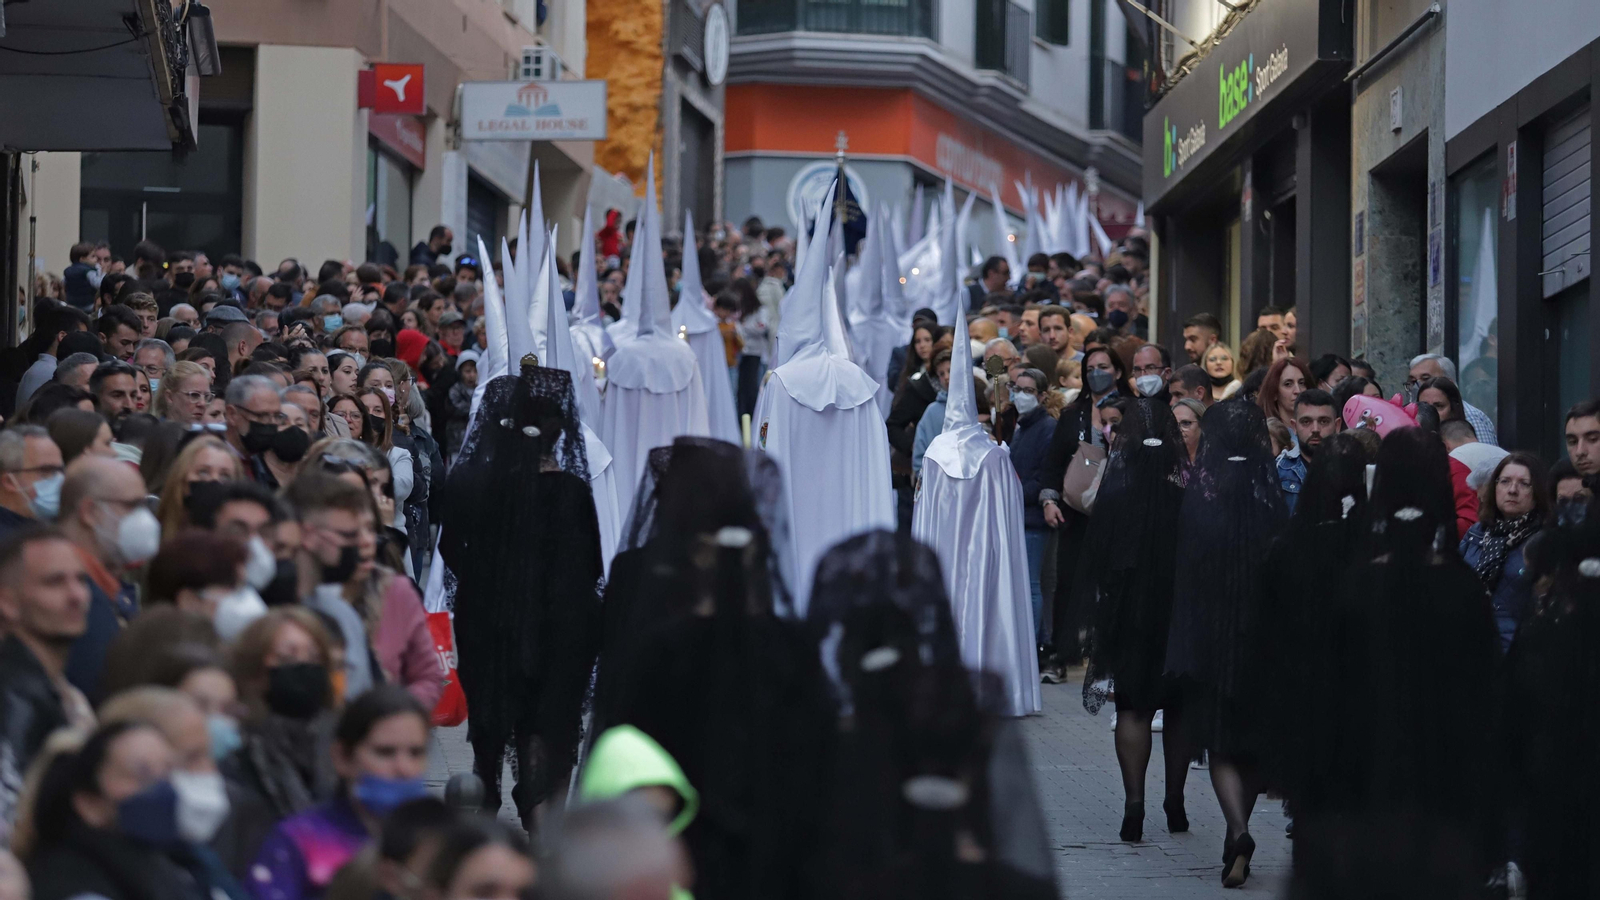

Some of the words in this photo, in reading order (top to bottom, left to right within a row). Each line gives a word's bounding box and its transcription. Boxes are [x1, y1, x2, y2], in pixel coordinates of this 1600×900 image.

[1255, 60, 1270, 101] Sport
[478, 119, 530, 132] LEGAL
[535, 118, 588, 131] HOUSE
